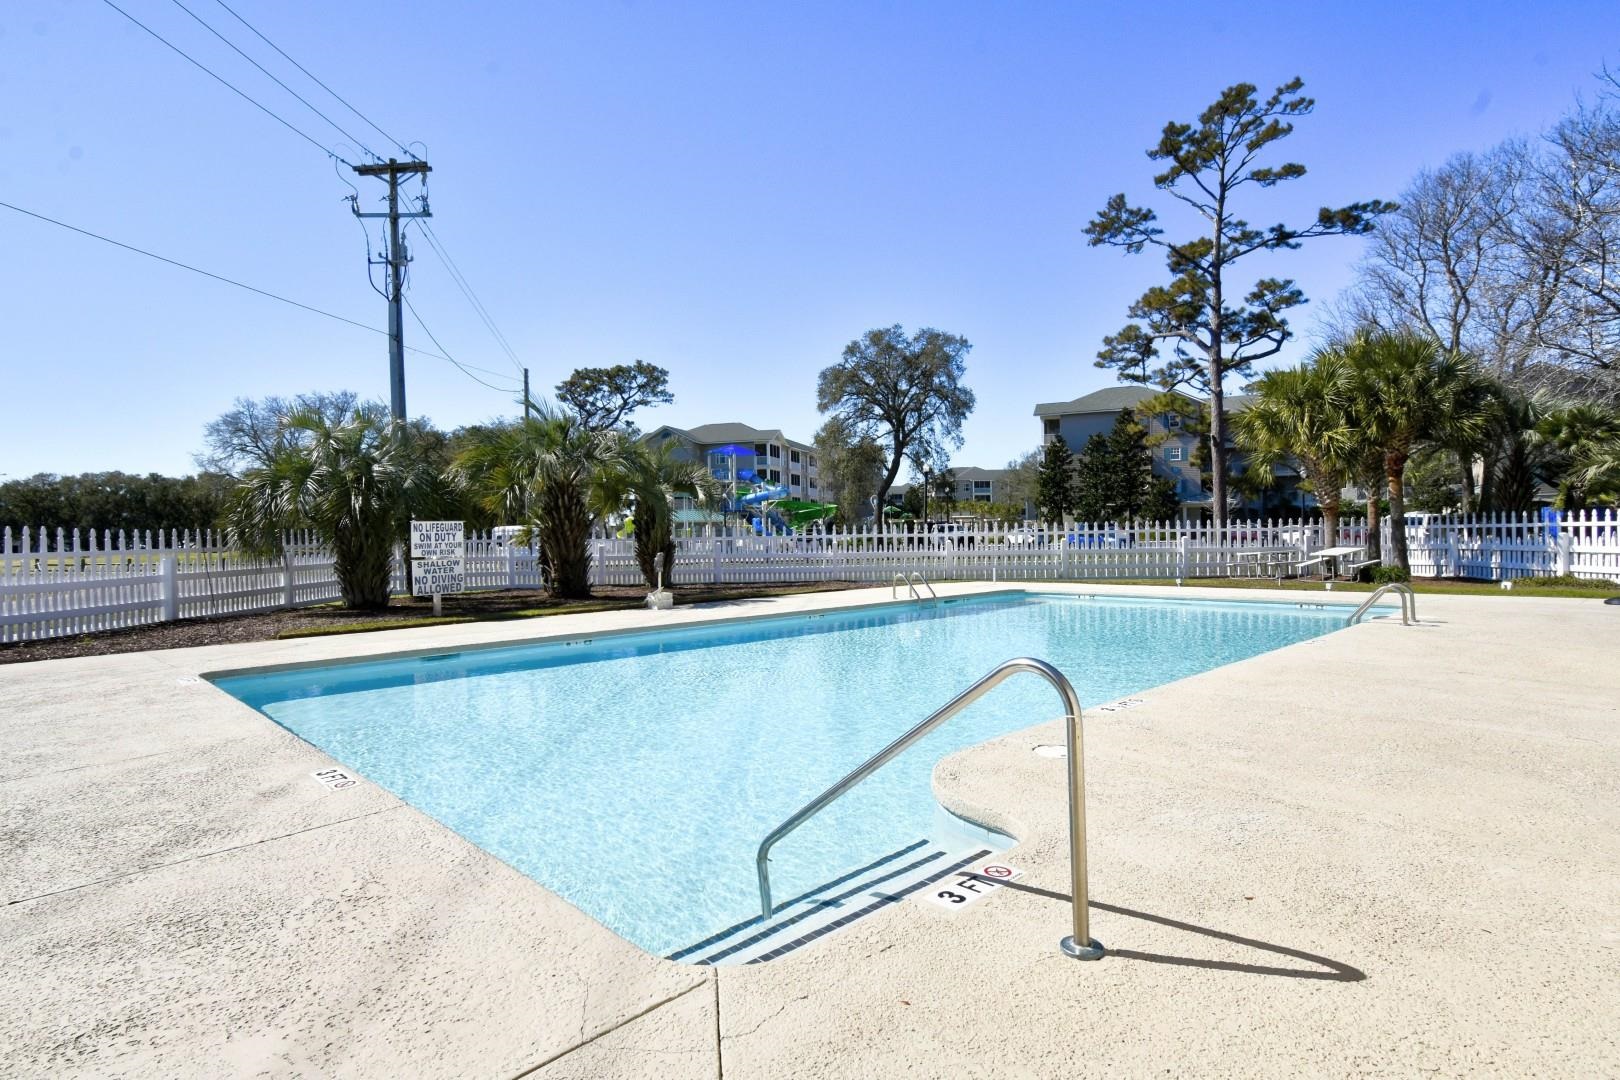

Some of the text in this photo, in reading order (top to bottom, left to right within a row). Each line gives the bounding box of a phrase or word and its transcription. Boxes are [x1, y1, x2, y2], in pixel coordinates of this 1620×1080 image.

[414, 523, 462, 532] NO LIFEGUARD
[420, 533, 456, 542] ON DUTY
[417, 560, 460, 568] SHALLOW
[414, 574, 463, 586] NO DIVING
[417, 584, 461, 595] ALLOWED
[938, 890, 966, 904] 3
[956, 876, 994, 893] FT
